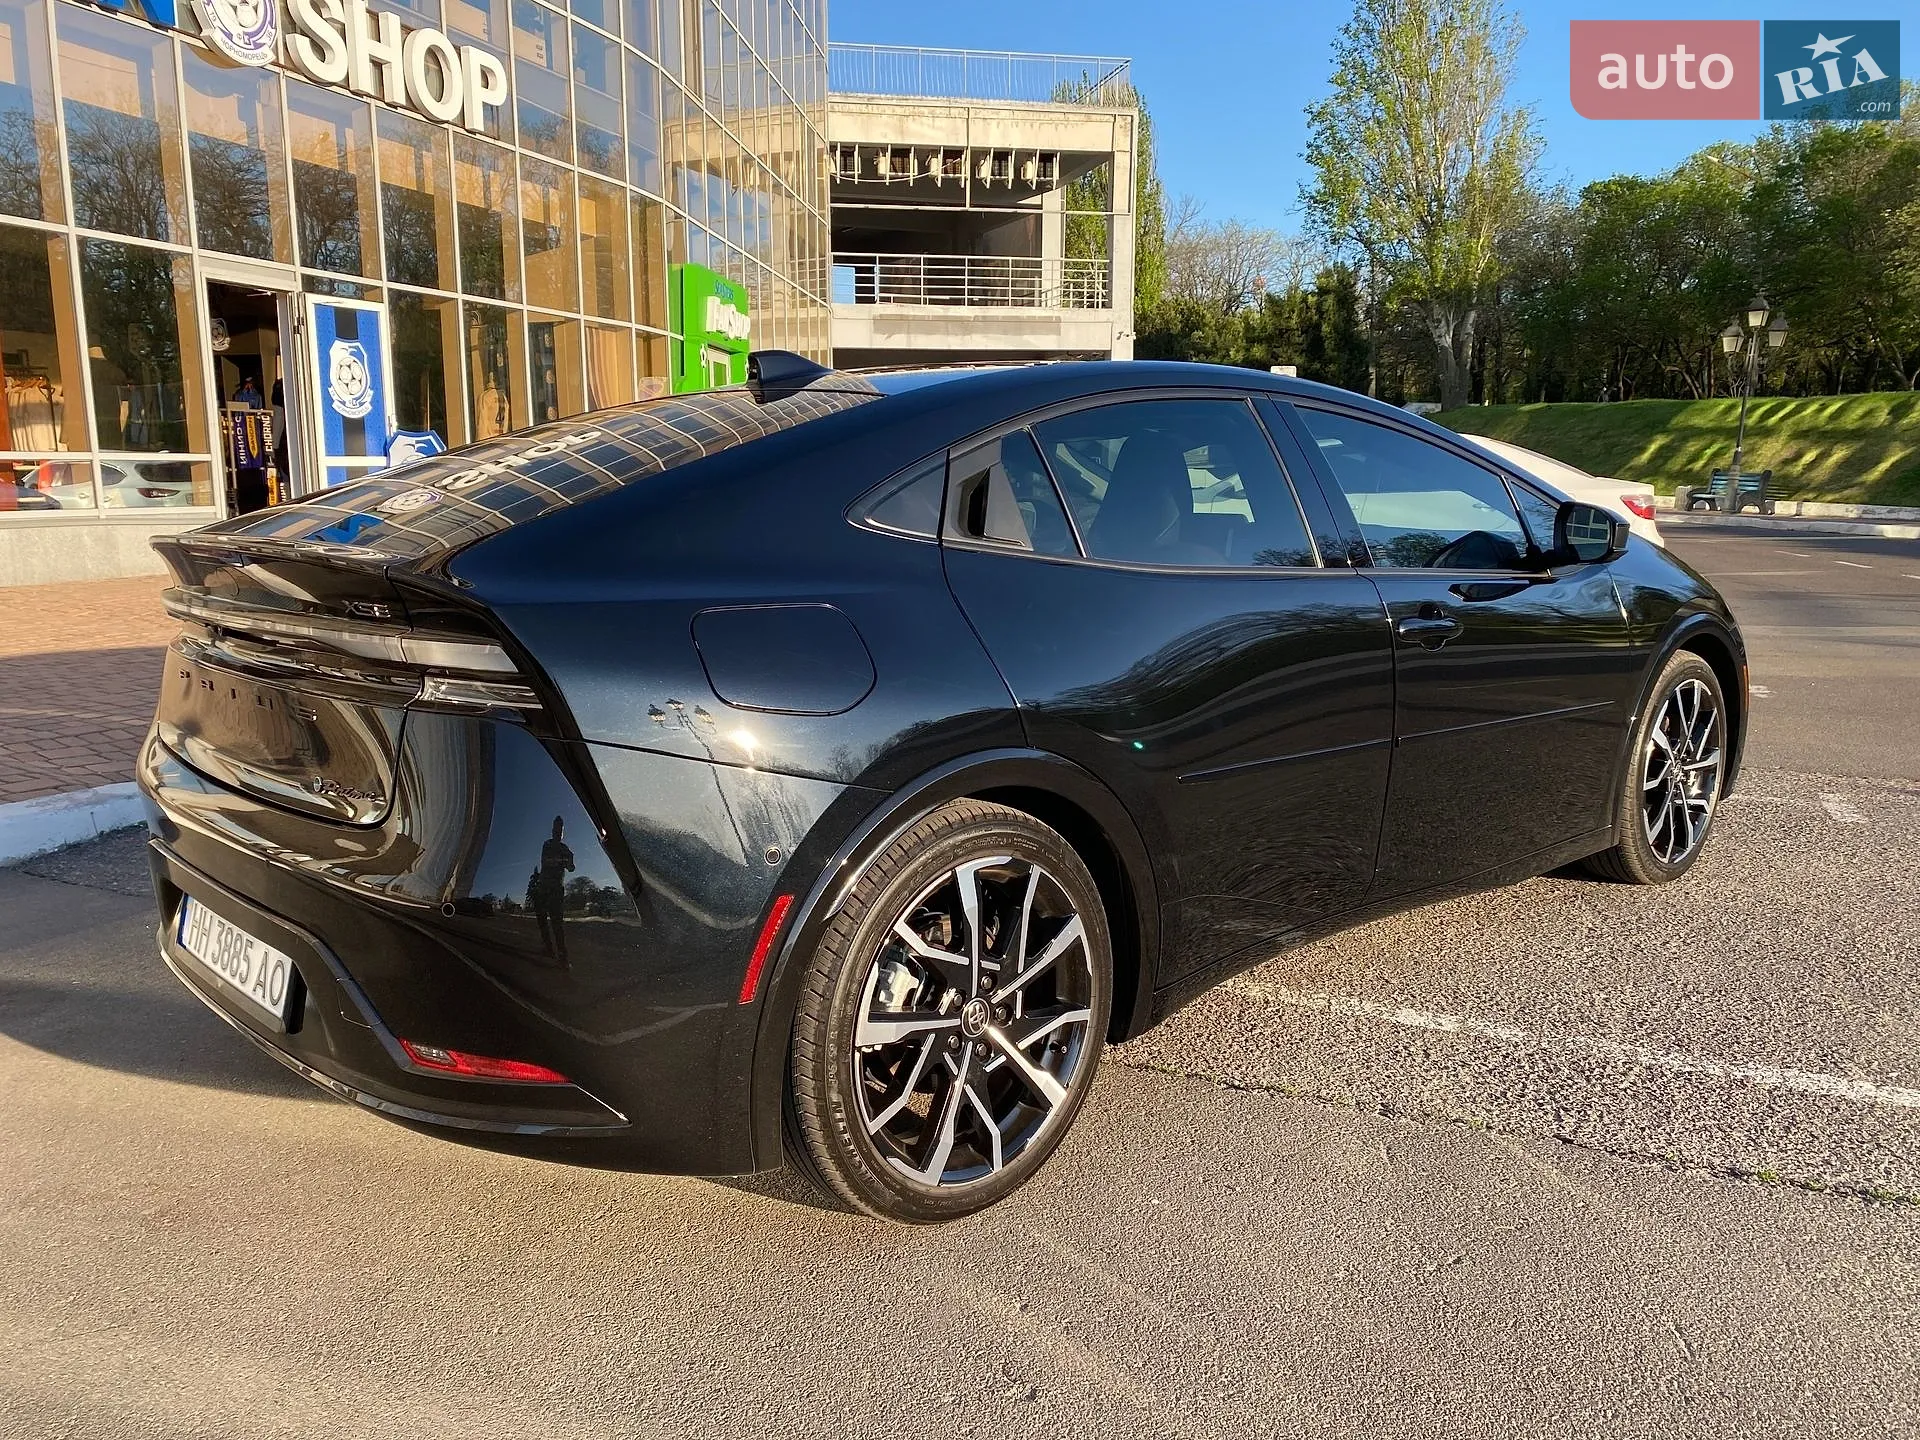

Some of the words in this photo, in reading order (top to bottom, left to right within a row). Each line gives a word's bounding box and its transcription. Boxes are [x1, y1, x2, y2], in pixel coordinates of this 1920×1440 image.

[286, 0, 508, 133] SHOP
[211, 919, 254, 984] 3885
[253, 949, 286, 1007] AO
